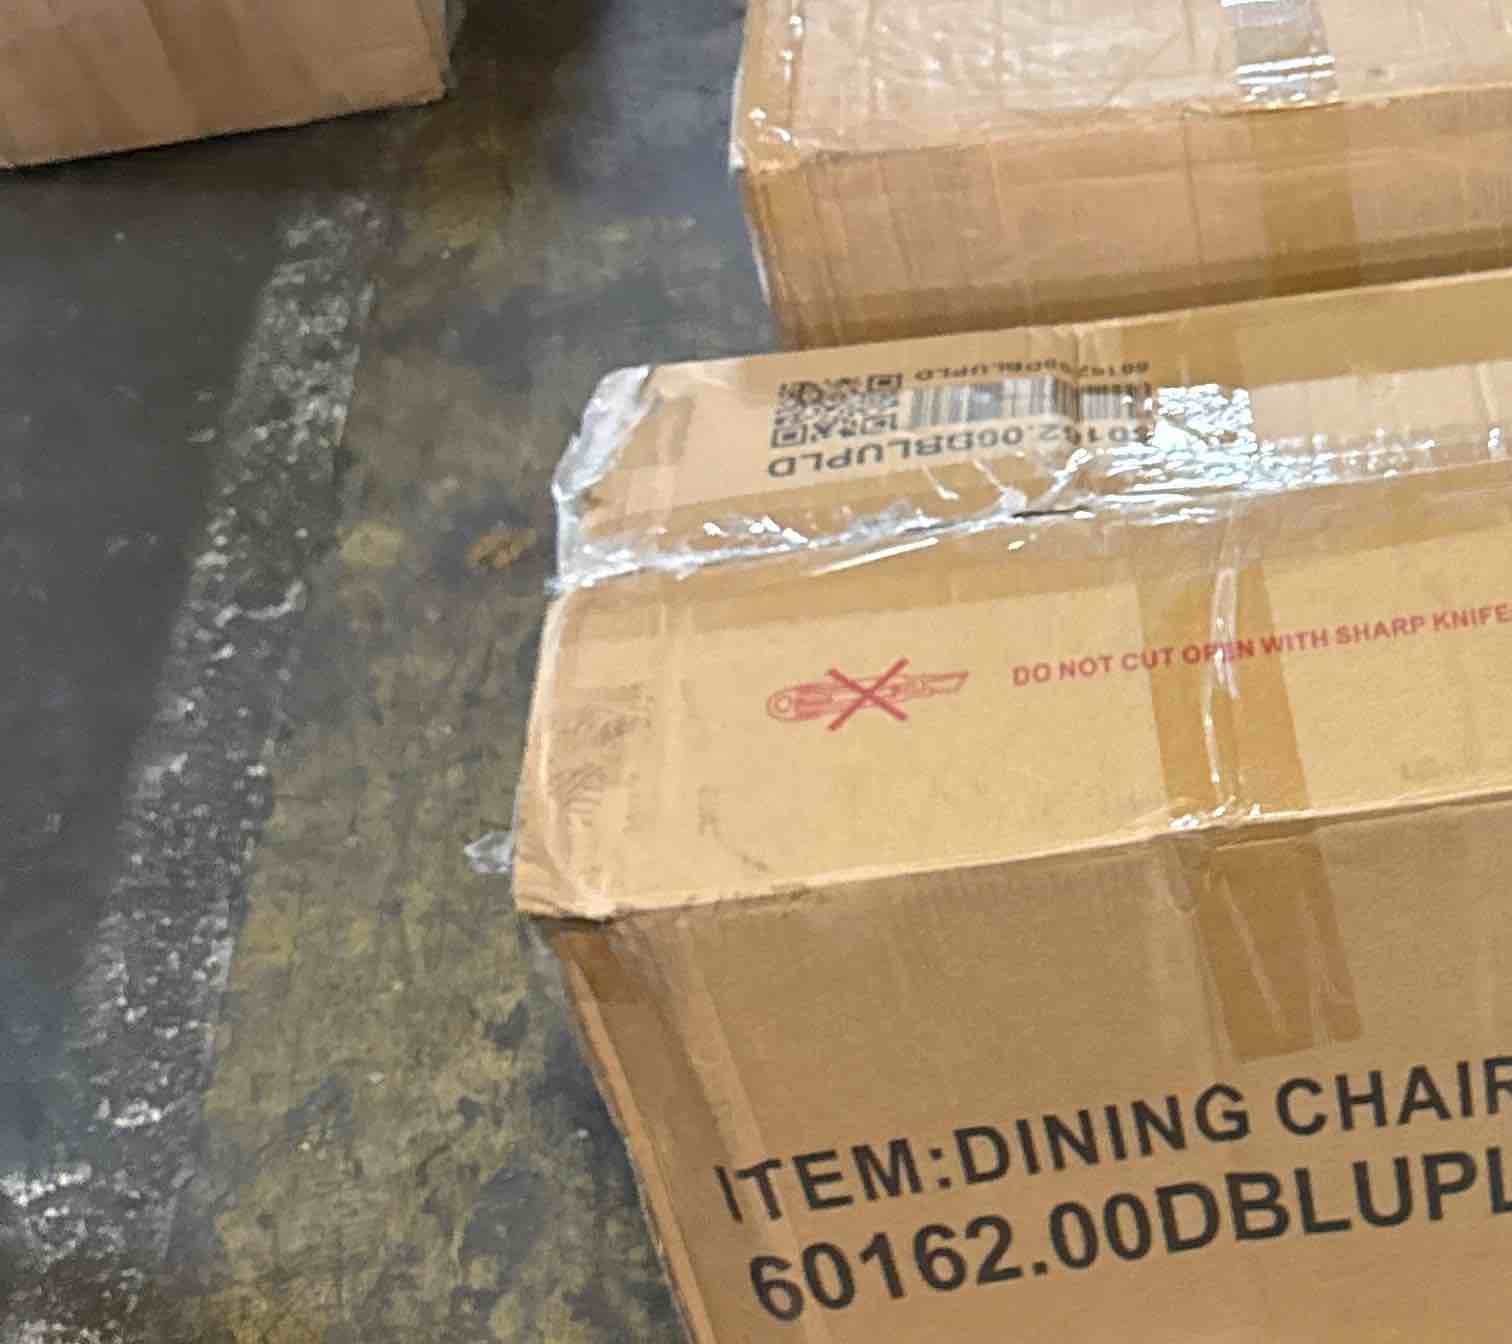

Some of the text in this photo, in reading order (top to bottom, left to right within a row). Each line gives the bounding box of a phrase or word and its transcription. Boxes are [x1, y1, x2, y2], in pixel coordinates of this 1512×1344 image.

[1012, 662, 1051, 687] DO
[1058, 654, 1114, 681] NOT
[1121, 646, 1176, 672] CUT
[1181, 638, 1255, 665] OPEN
[1260, 627, 1329, 656] WITH
[1335, 614, 1426, 646] SHARP
[714, 1083, 1251, 1224] ITEM:DINING
